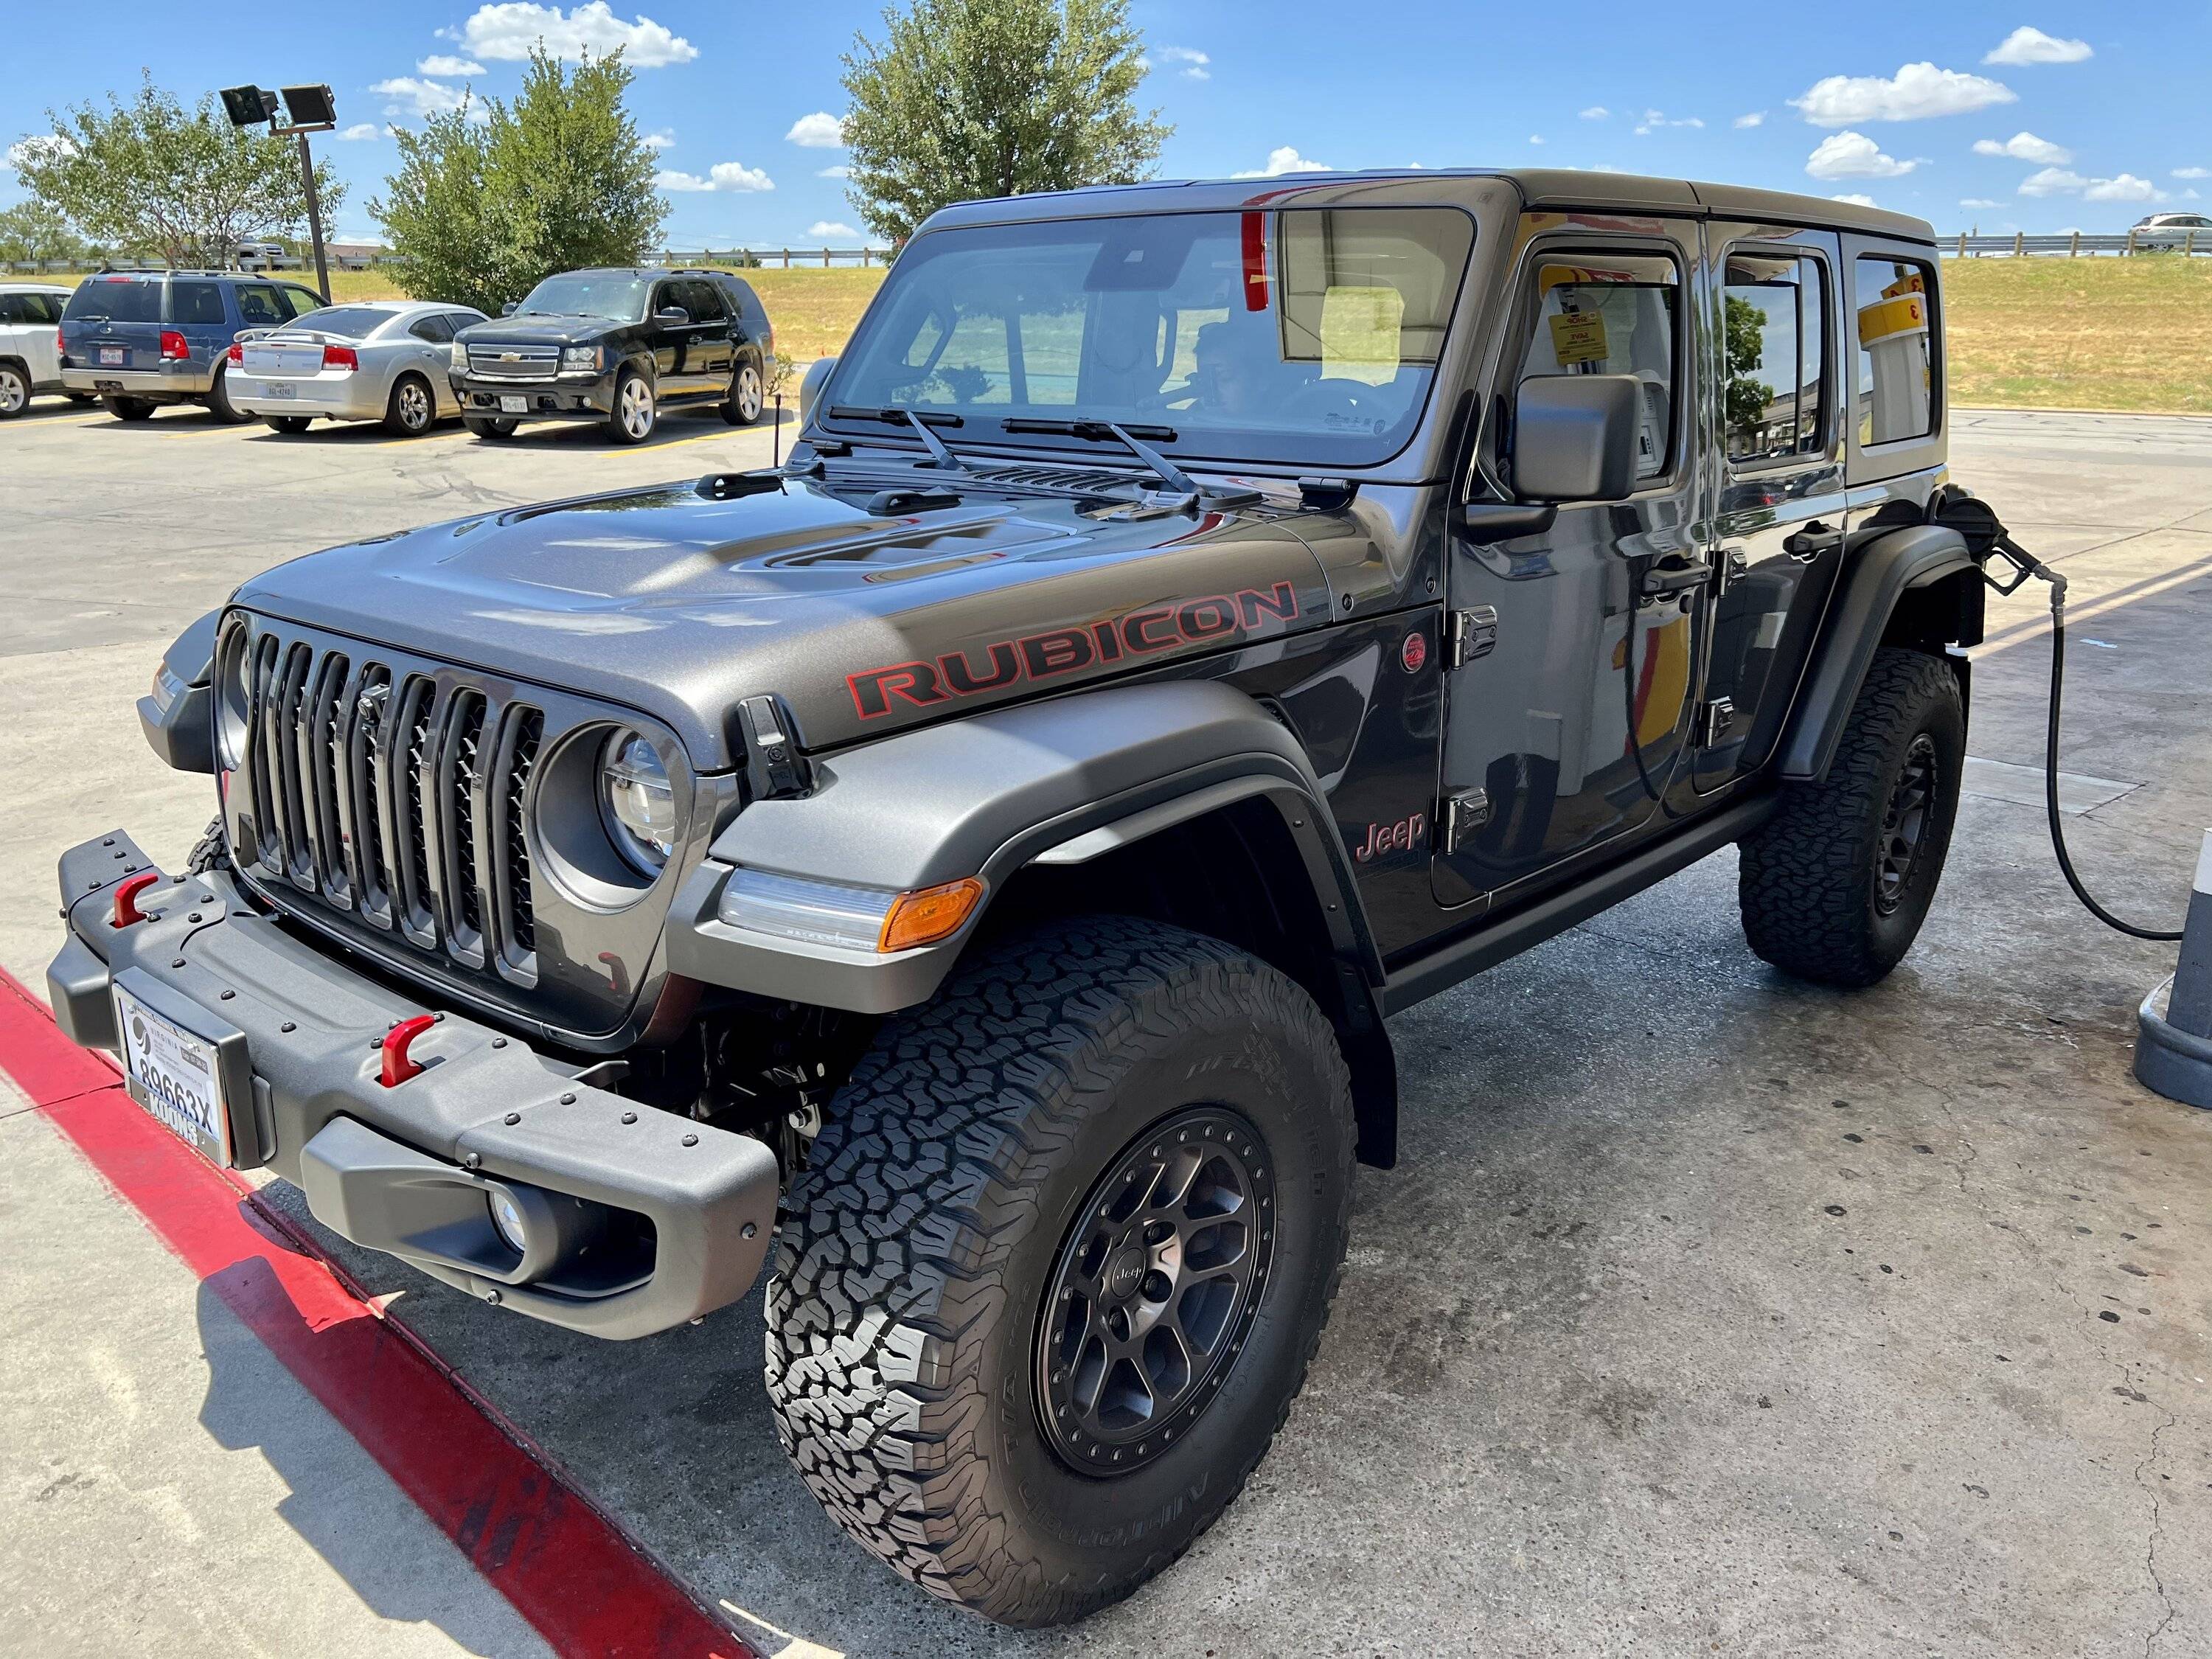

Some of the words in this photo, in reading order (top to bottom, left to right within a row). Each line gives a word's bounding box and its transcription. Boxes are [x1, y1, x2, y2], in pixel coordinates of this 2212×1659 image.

[845, 580, 1299, 720] RUBICON
[1355, 813, 1427, 863] Jeep
[150, 1026, 177, 1049] VIRGINIA
[140, 1058, 214, 1134] 89663X
[148, 1092, 199, 1147] KOONS
[1116, 1267, 1142, 1281] Jeep
